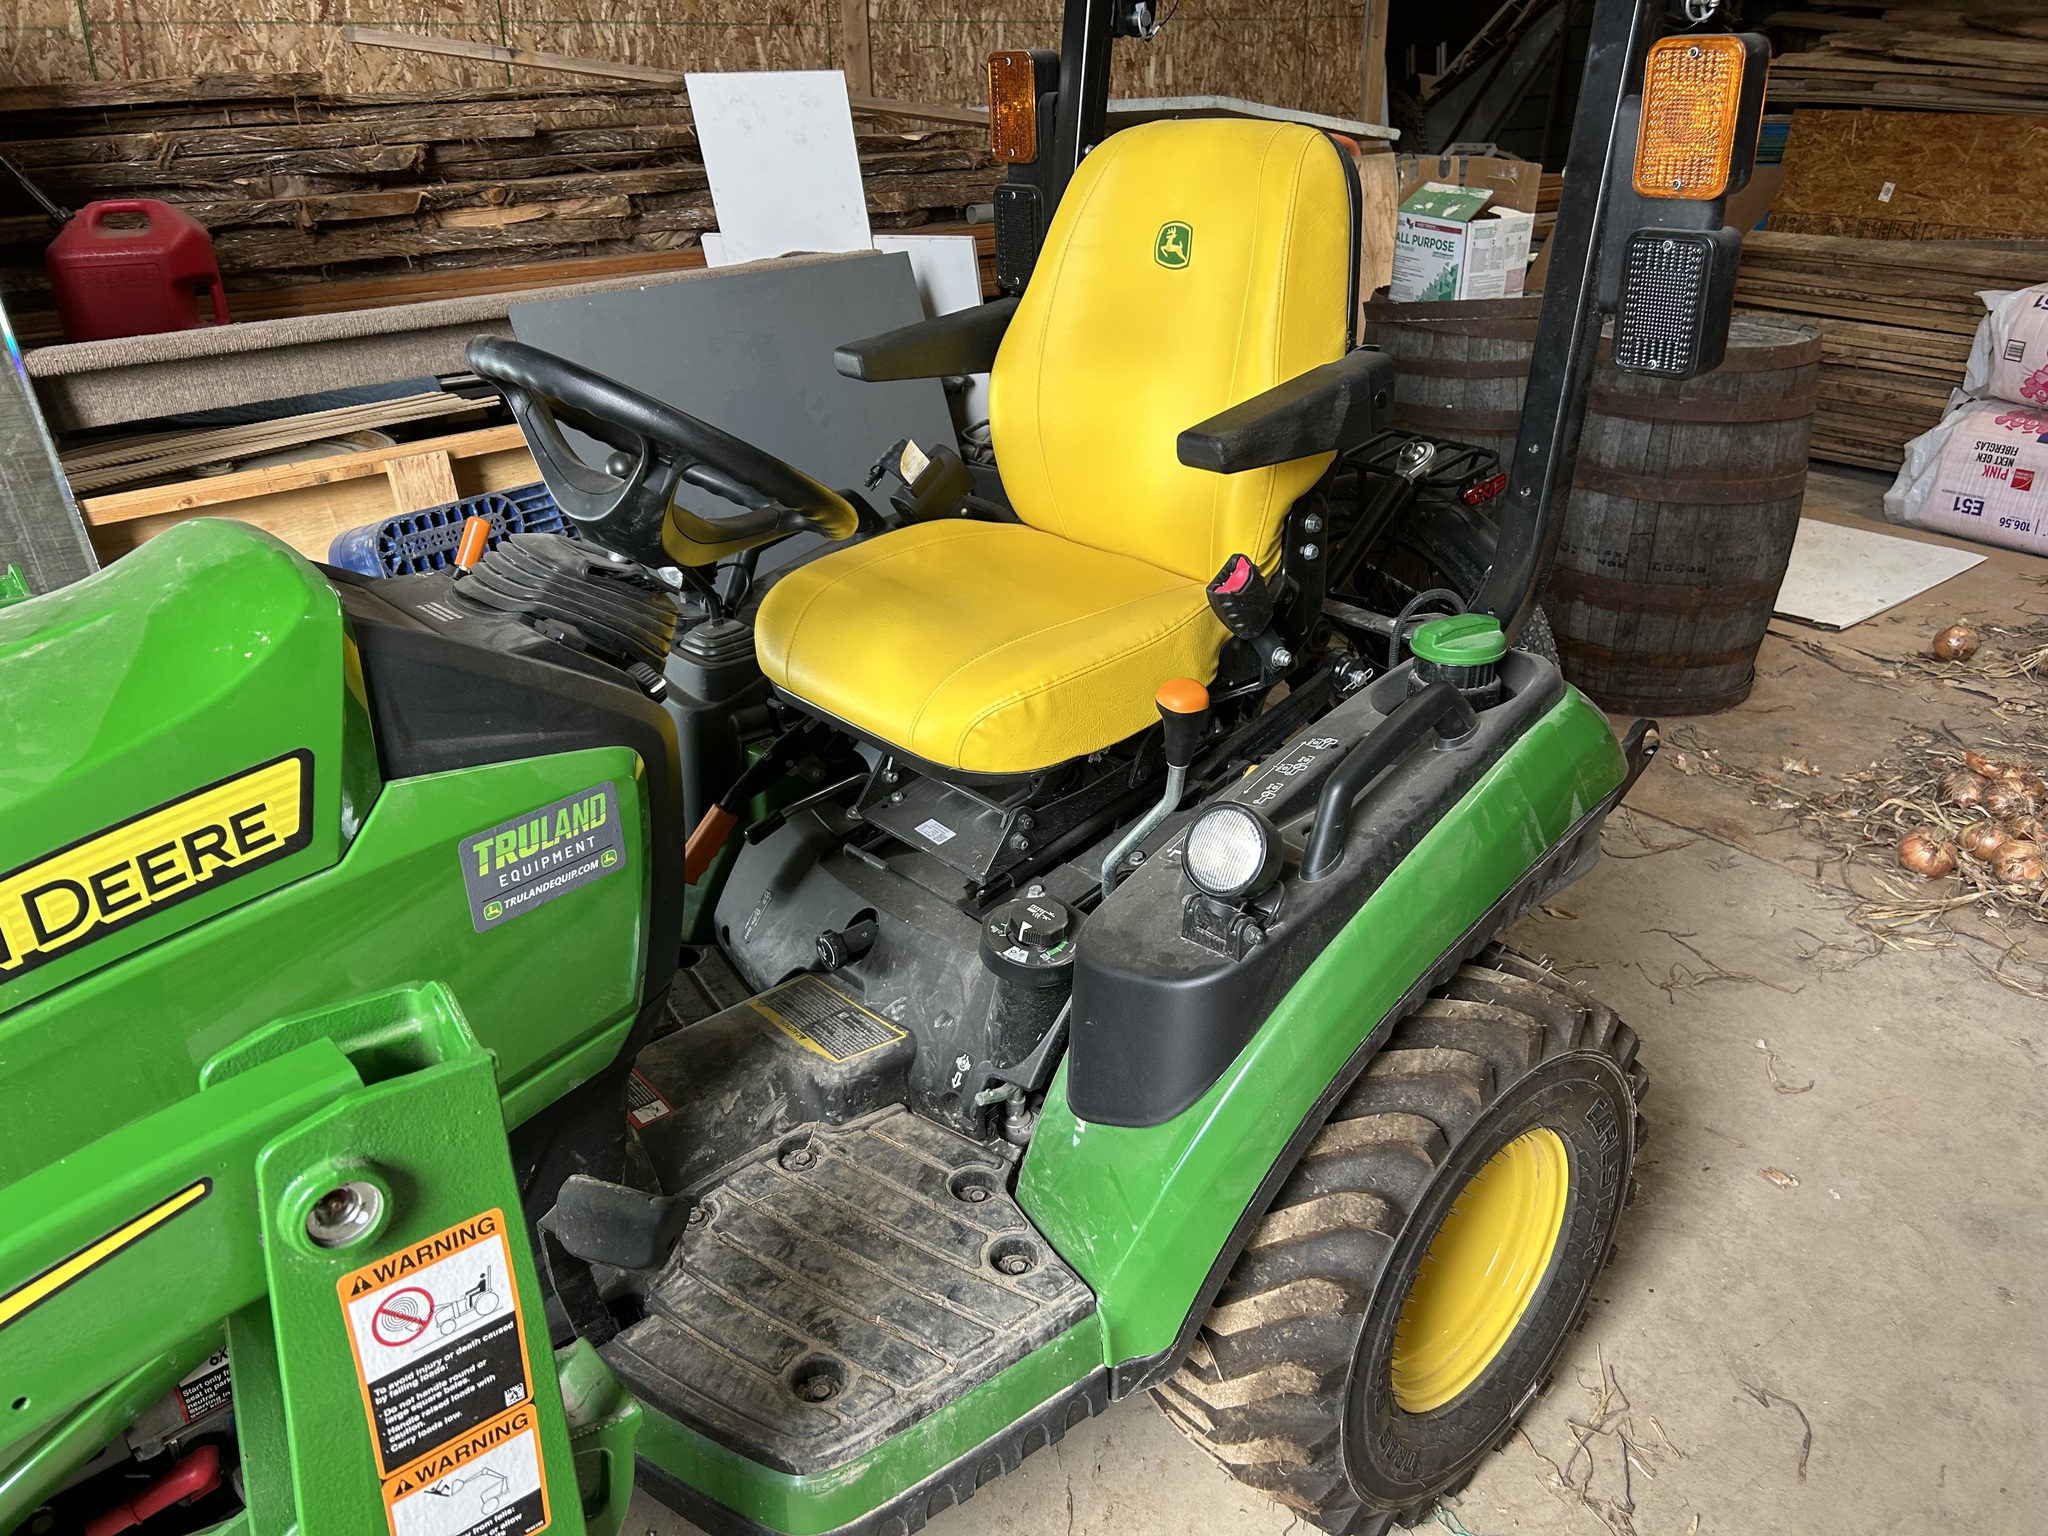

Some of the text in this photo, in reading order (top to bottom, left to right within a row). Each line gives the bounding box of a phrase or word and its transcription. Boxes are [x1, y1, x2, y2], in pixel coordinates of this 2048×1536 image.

[1396, 231, 1411, 245] ALL
[1412, 235, 1455, 253] PURPOSE
[1975, 440, 2019, 457] FIBERGLAS
[1976, 452, 2015, 468] NEXT GEN
[1982, 464, 2010, 481] PINK
[1952, 496, 1985, 517] E51
[1999, 516, 2031, 532] 106.56
[473, 792, 606, 877] TRULAND
[21, 802, 278, 947] DEERE
[499, 836, 595, 888] EQUIPMENT
[504, 859, 599, 909] TRULANDEQUIP.COM
[373, 1216, 495, 1283] WARNING
[374, 1321, 514, 1397] To avoid injury or death caused
[182, 1383, 204, 1397] Start
[204, 1373, 222, 1386] only
[185, 1377, 231, 1404] seat in park
[375, 1363, 449, 1405] by falling loads:
[383, 1359, 487, 1417] Do not handle round or
[188, 1391, 219, 1410] neutral.
[189, 1396, 221, 1415] Starting
[385, 1377, 471, 1426] large square bales.
[387, 1374, 496, 1436] Handle raised loads with
[389, 1421, 426, 1443] caution.
[390, 1411, 463, 1453] Carry loads low.
[415, 1413, 529, 1483] WARNING
[472, 1506, 516, 1534] from falls:
[500, 1513, 522, 1530] allow
